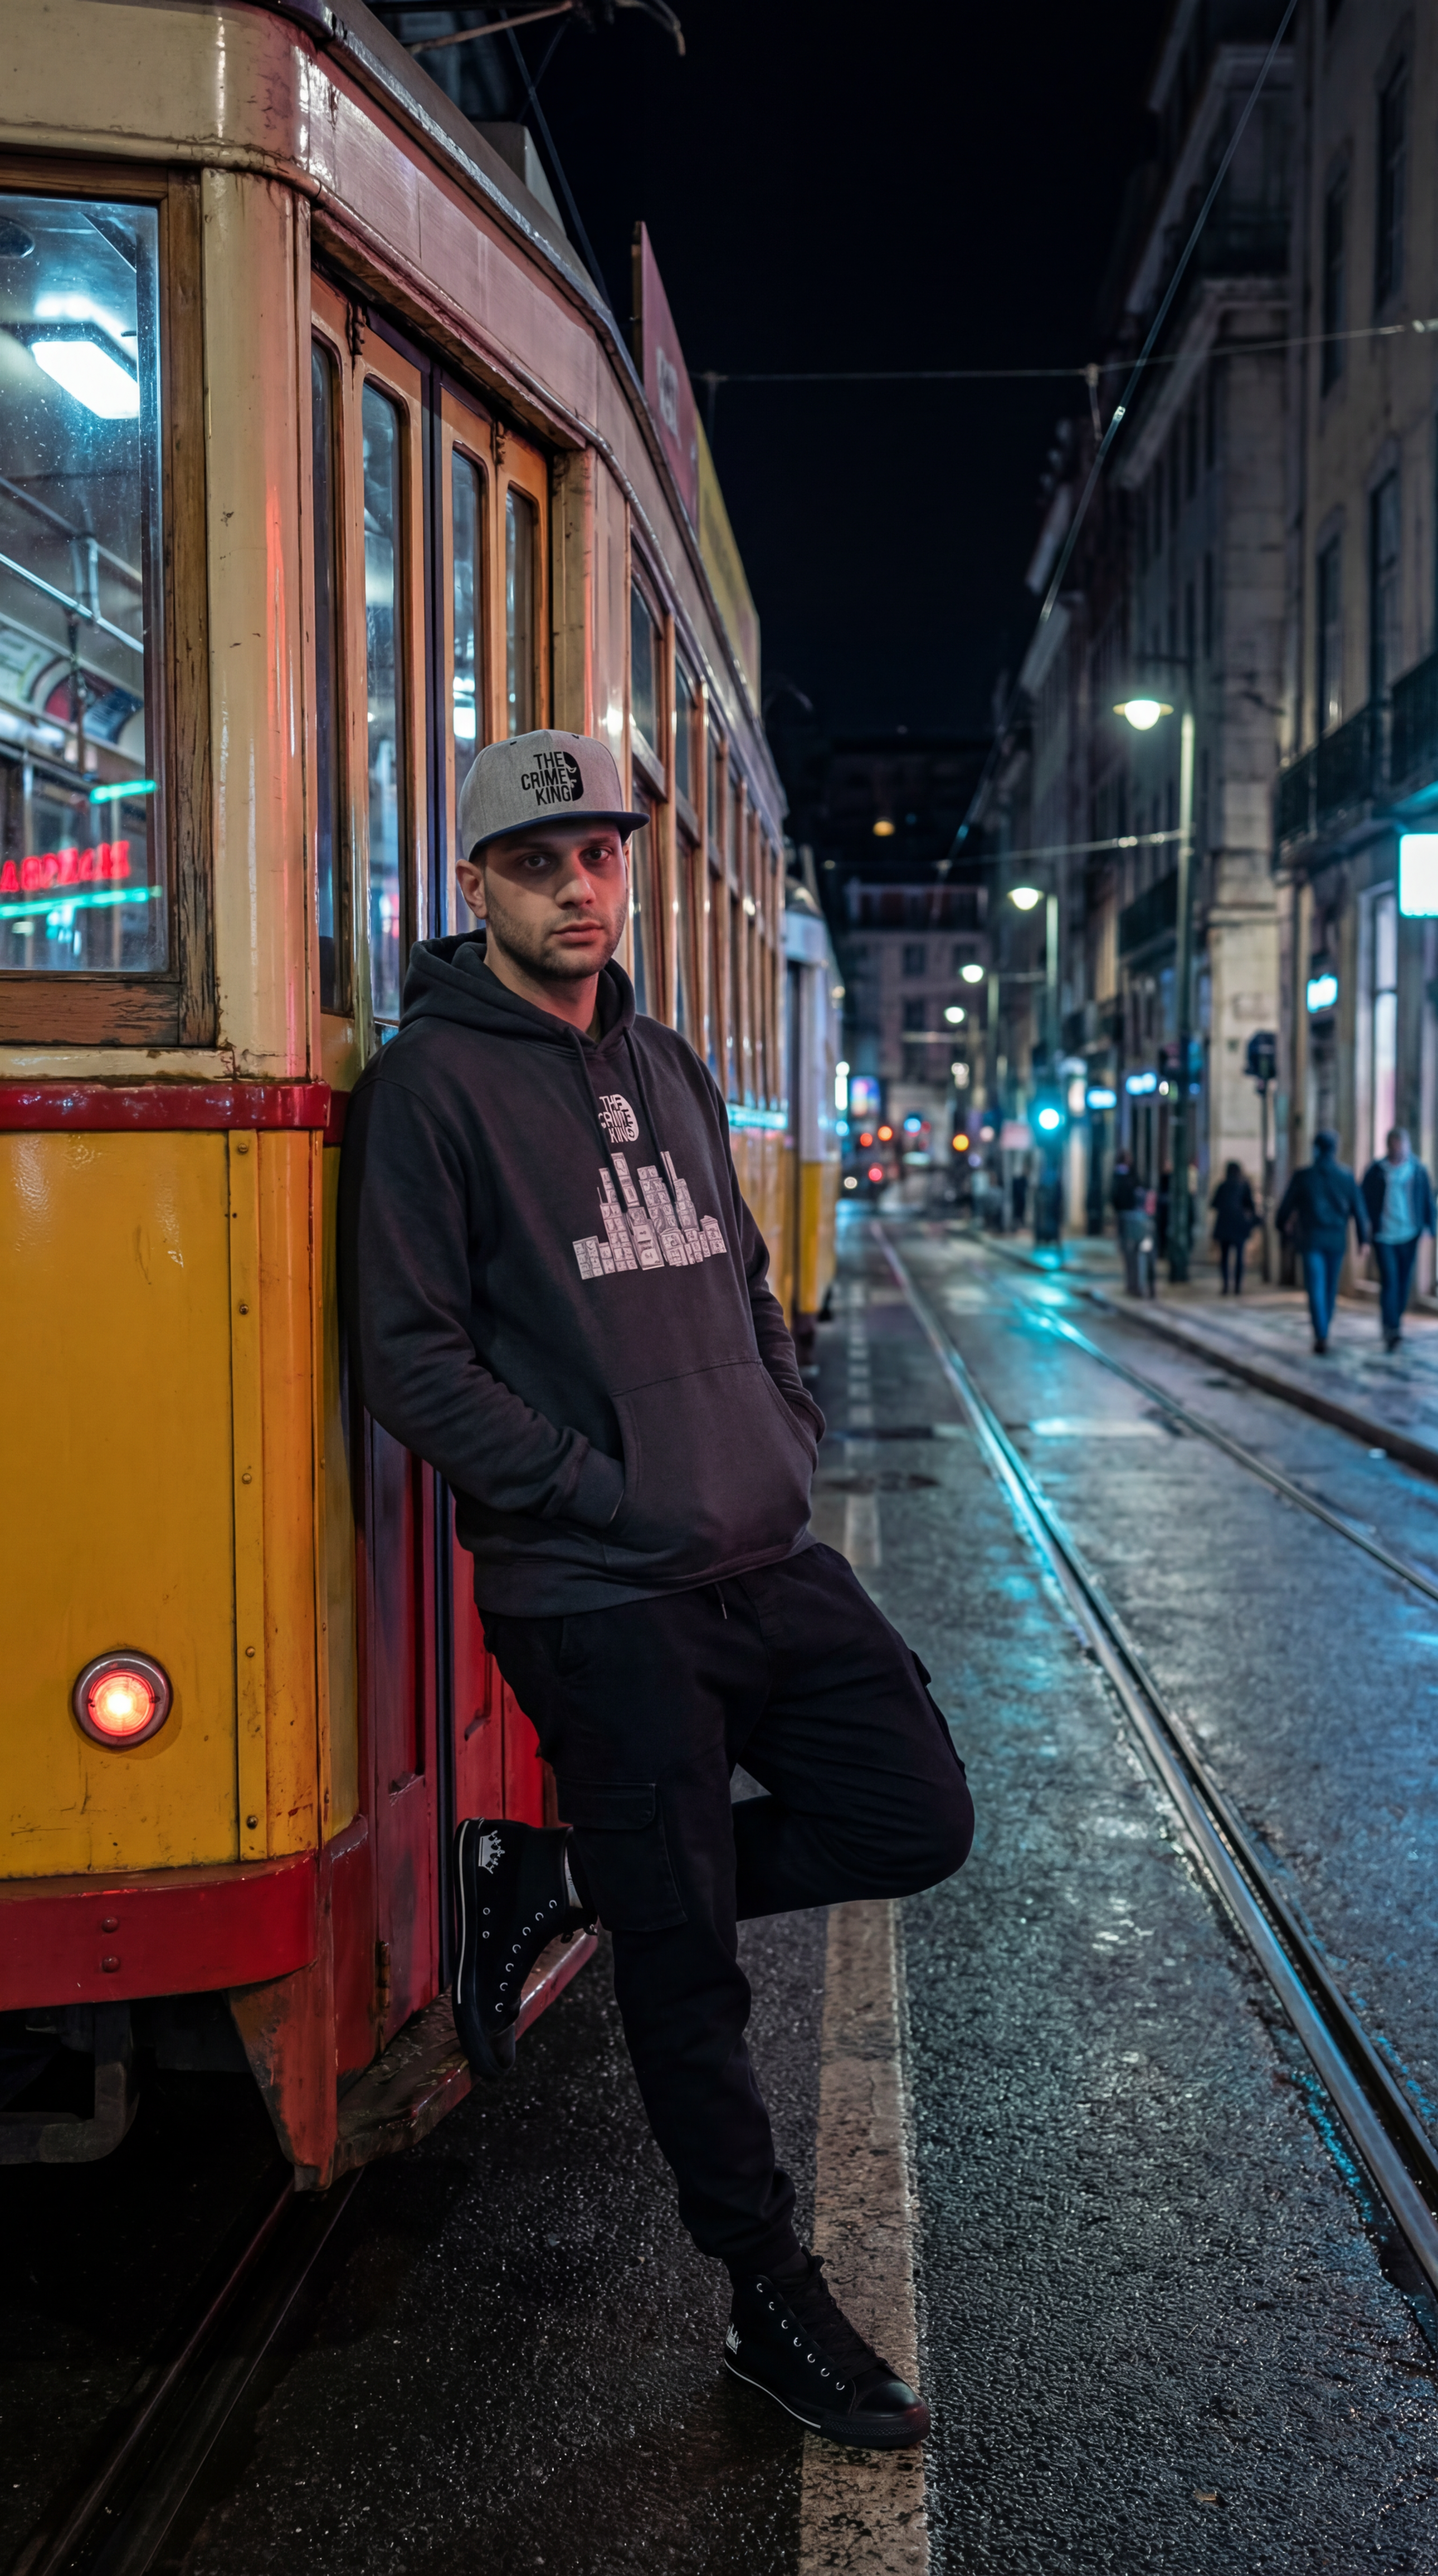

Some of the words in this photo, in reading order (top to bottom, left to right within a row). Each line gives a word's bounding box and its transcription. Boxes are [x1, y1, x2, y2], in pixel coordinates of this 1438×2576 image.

[533, 751, 564, 770] THE
[521, 768, 567, 790] CRIME
[536, 785, 571, 805] KING
